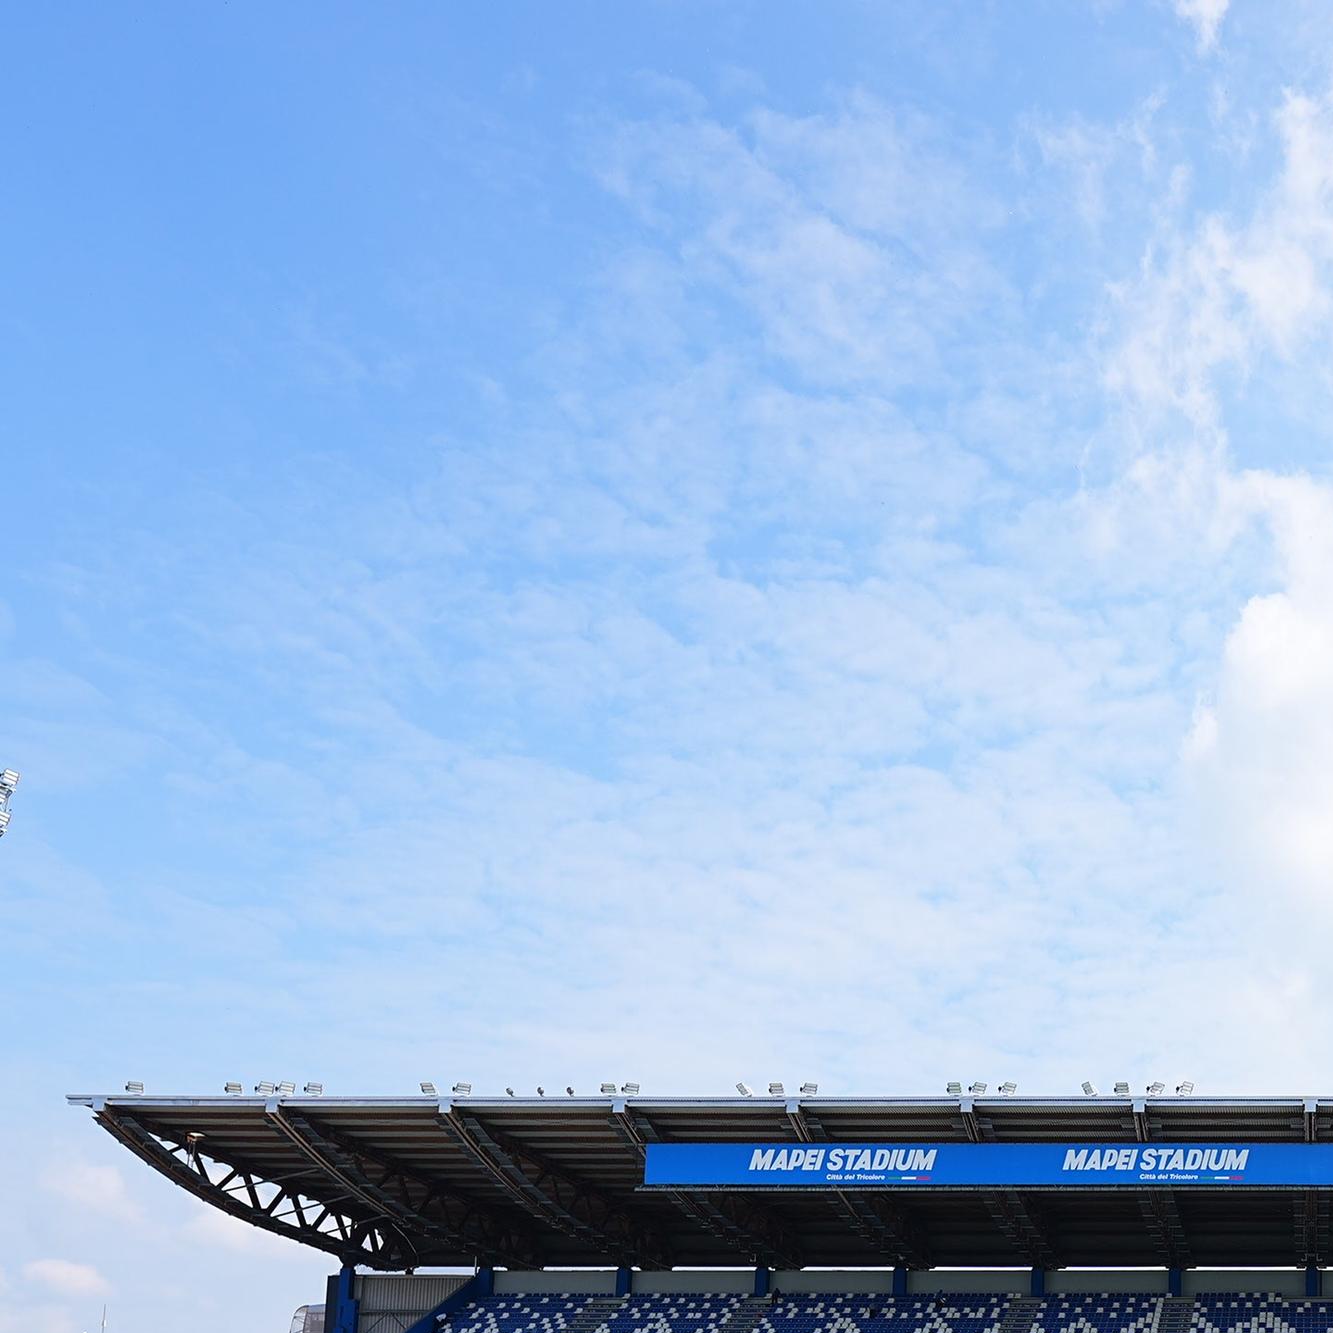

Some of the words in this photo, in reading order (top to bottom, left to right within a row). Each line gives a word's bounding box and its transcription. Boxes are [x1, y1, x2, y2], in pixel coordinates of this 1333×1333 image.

[749, 1149, 825, 1171] MAPEI
[826, 1148, 937, 1171] STADIUM
[1062, 1149, 1138, 1171] MAPEI
[1140, 1148, 1249, 1171] STADIUM
[826, 1173, 842, 1181] Città
[844, 1173, 855, 1181] del
[856, 1173, 885, 1181] Tricolore
[1139, 1173, 1155, 1181] Città
[1157, 1173, 1168, 1181] del
[1170, 1173, 1198, 1181] Tricolore
